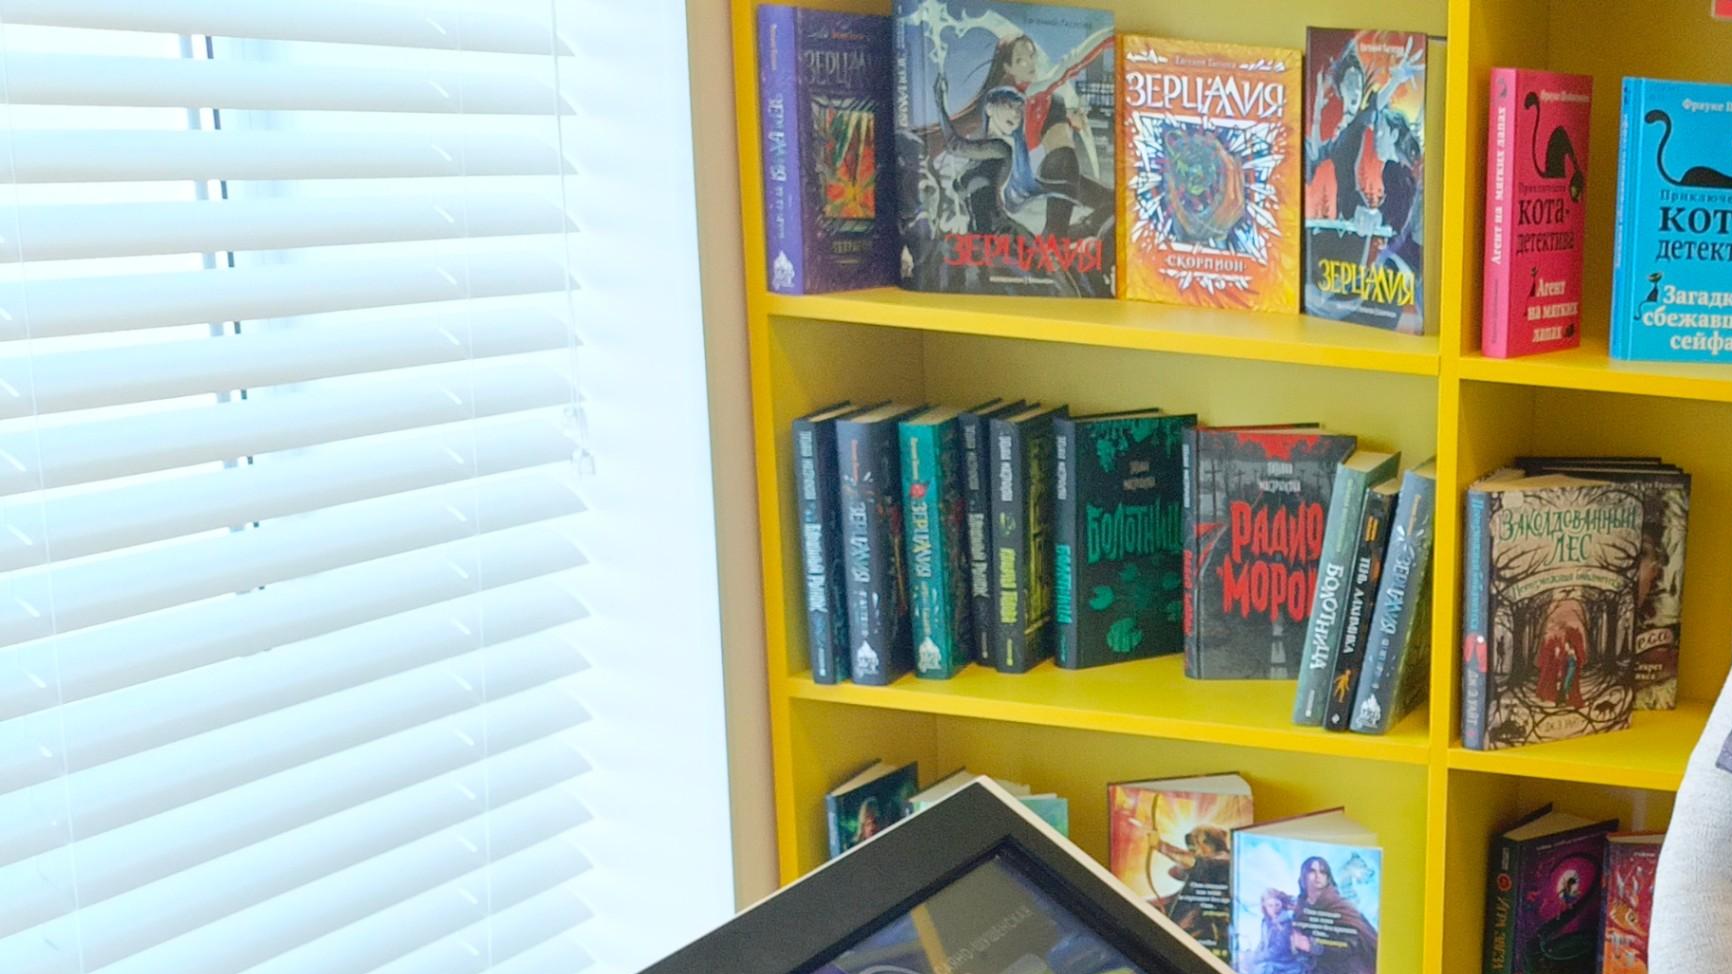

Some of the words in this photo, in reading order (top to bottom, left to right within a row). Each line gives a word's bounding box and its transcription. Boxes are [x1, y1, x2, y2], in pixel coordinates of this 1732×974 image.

[1126, 72, 1284, 118] ЗЕРЦАЛИЯ
[1682, 97, 1724, 113] Фрауке
[1518, 199, 1571, 226] кота-
[944, 233, 1104, 273] ЗЕРЦАЛИЯ
[1516, 230, 1575, 256] детектива
[1167, 255, 1244, 274] СКОРПИОН
[1318, 258, 1415, 307] ЗЕРЦАЛИЯ
[1536, 278, 1566, 298] Агент
[1527, 306, 1541, 321] на
[910, 502, 932, 578] ЗЕРЦАЛИЯ
[1230, 500, 1324, 565] РАДИО
[1500, 506, 1637, 542] ЗАКОЛДОВАННЫЙ
[1544, 533, 1593, 565] ЛЕС
[1379, 553, 1416, 636] ЗЕРЦАЛИЯ
[1309, 561, 1345, 671] БОЛОТНИЦА
